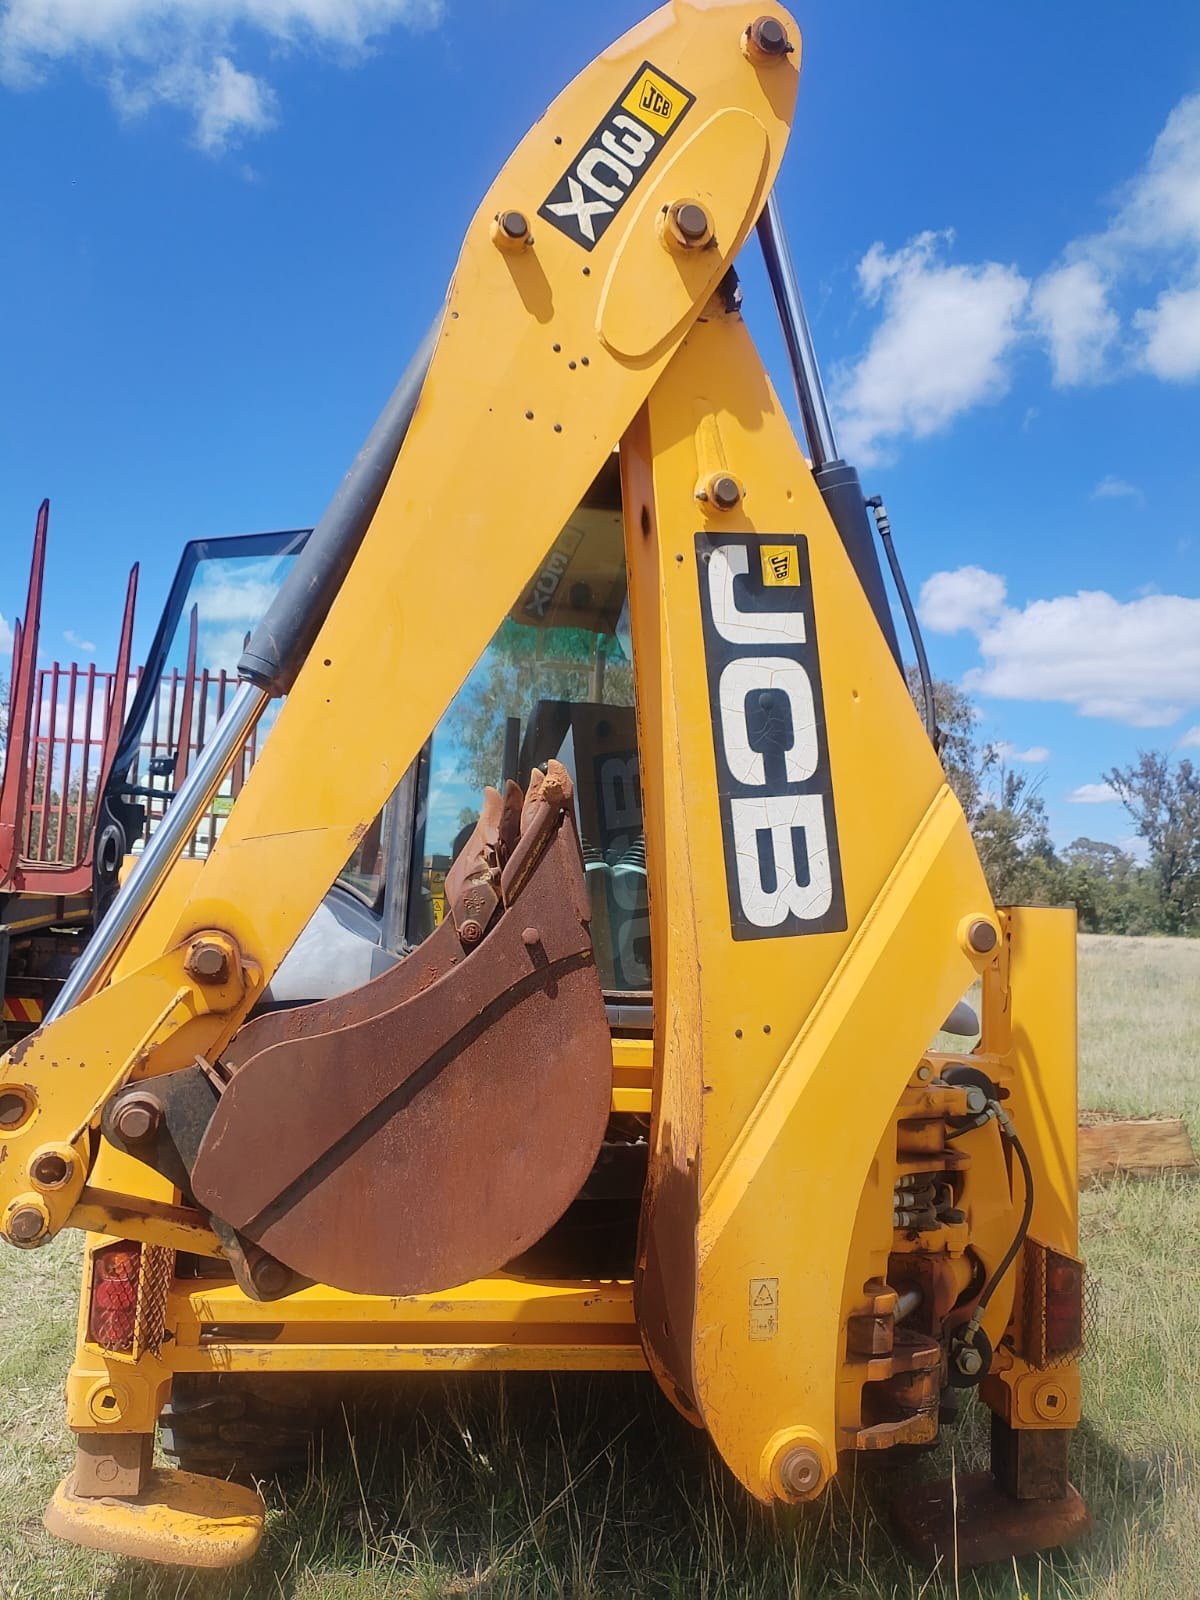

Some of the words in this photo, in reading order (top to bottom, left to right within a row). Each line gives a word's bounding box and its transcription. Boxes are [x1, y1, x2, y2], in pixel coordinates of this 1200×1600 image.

[643, 86, 670, 117] JCB
[545, 114, 655, 242] 3CX
[771, 556, 788, 579] JCB
[708, 544, 833, 927] JCB
